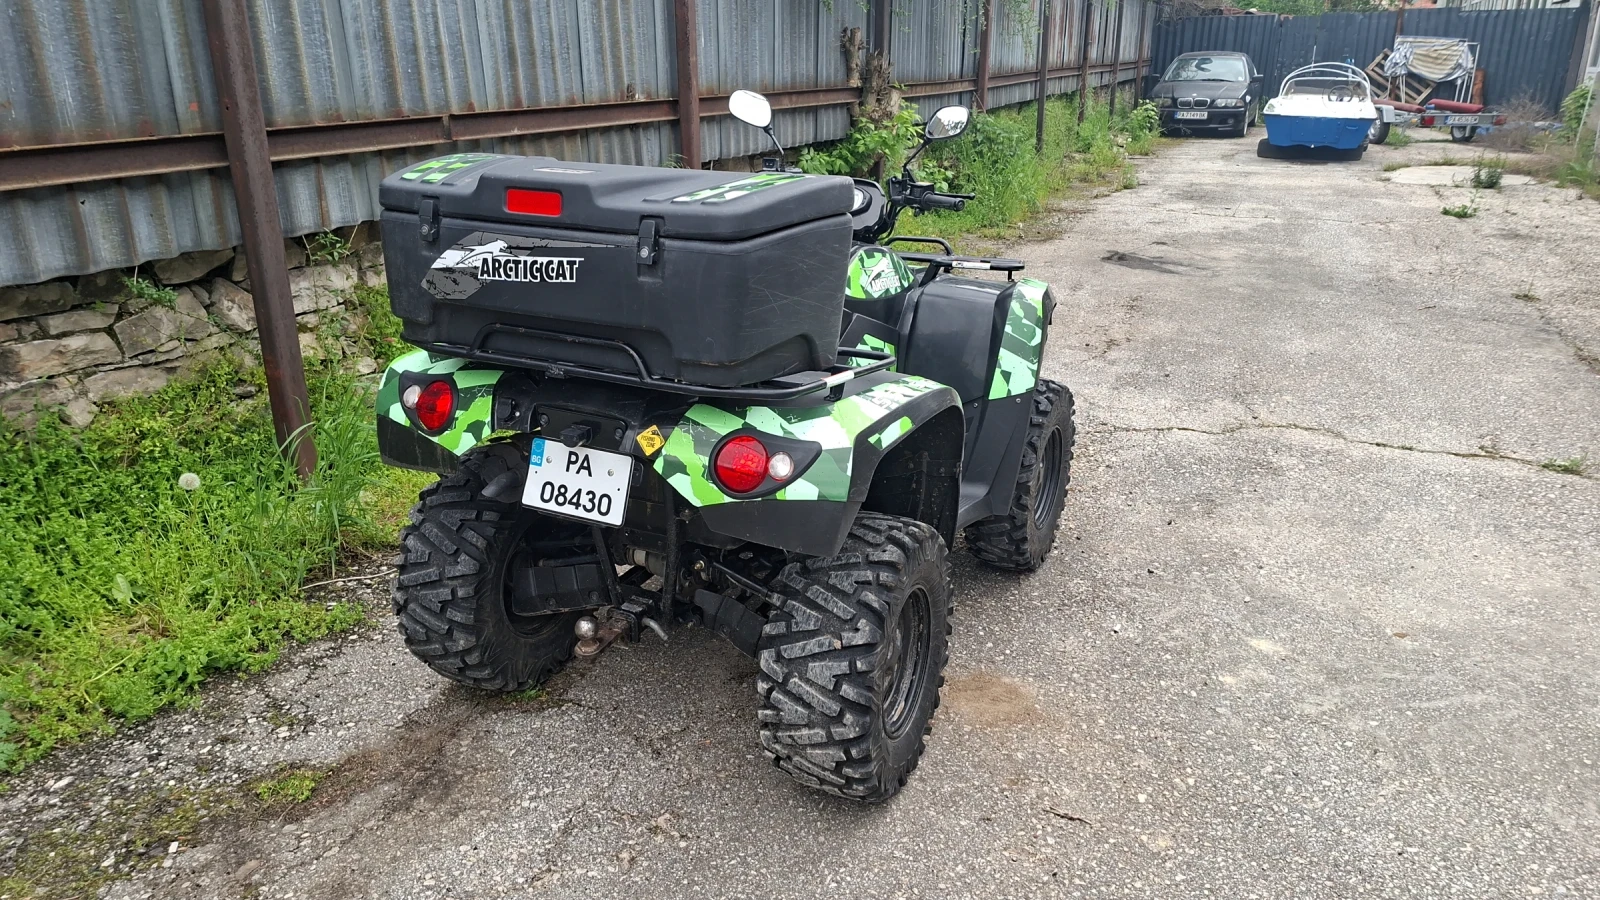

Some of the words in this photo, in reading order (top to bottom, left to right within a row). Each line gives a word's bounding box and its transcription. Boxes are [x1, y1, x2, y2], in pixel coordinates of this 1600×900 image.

[479, 256, 540, 282] ARCTIC
[543, 258, 578, 282] CAT
[531, 454, 541, 464] BG
[565, 450, 592, 477] PA
[539, 480, 612, 517] 08430
